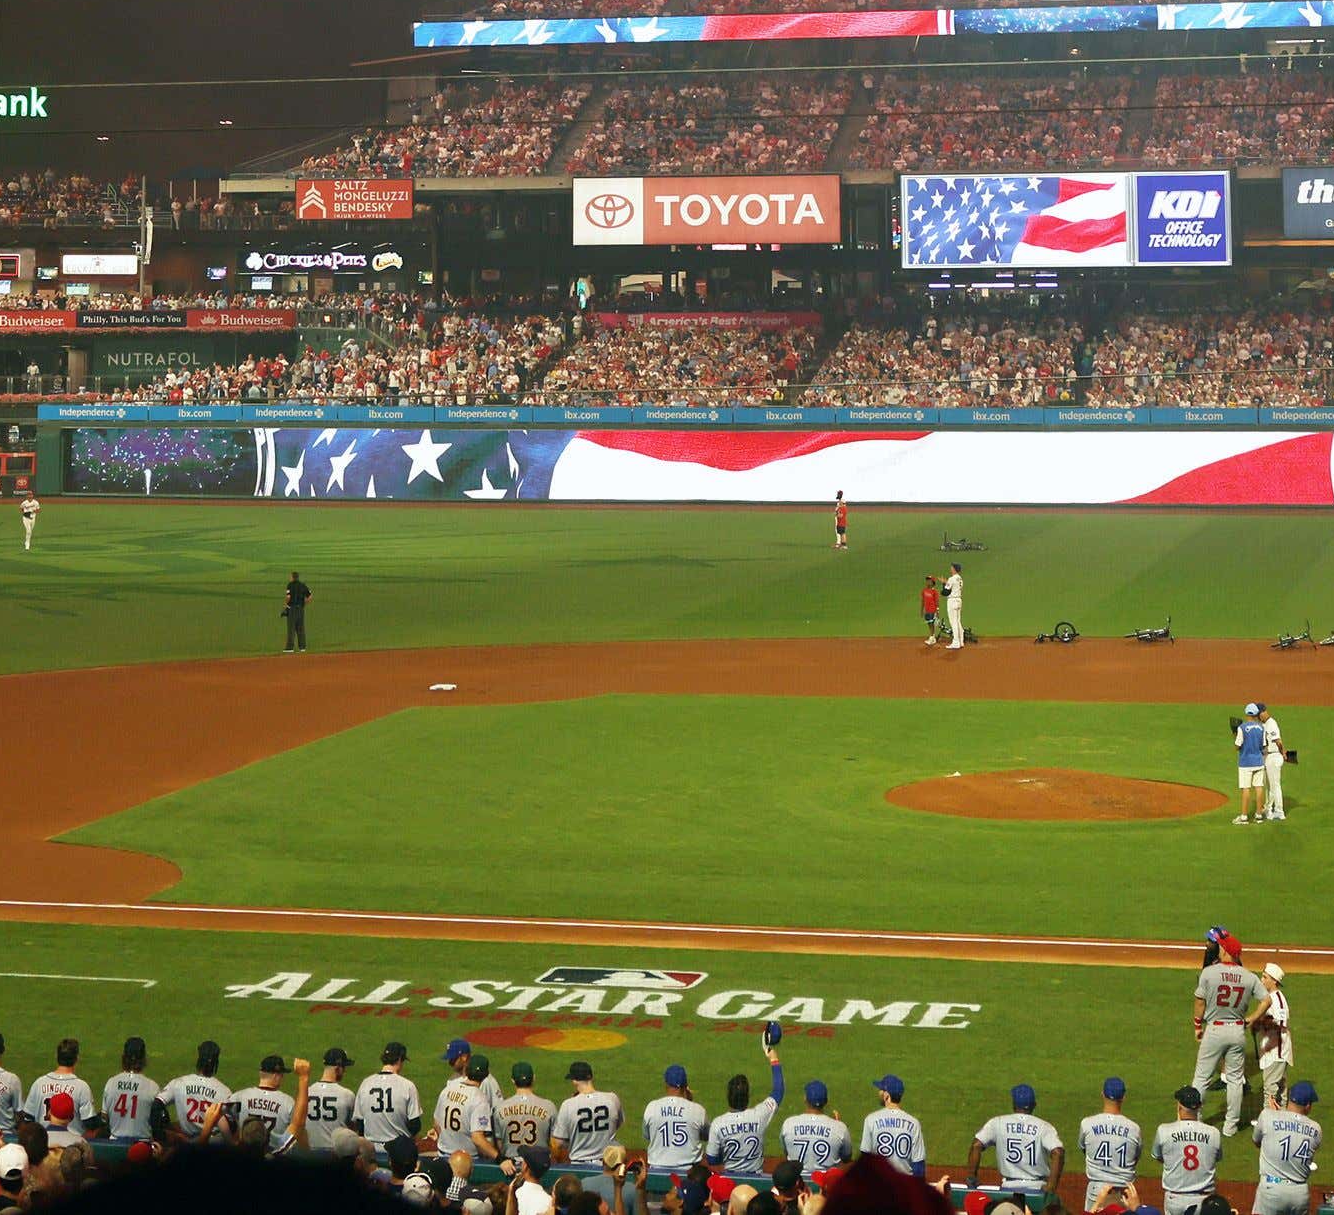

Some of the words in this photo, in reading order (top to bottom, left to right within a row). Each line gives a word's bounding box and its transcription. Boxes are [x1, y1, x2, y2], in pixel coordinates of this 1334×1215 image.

[334, 180, 368, 190] SALTZ
[334, 191, 409, 201] MONGELUZZI
[334, 202, 393, 212] BENDESKY
[654, 192, 824, 227] TOYOTA
[1164, 221, 1202, 234] OFFICE
[1148, 233, 1222, 248] TECHNOLOGY
[83, 315, 108, 324] Philly,
[109, 315, 128, 324] This
[129, 315, 151, 324] Bud's
[152, 315, 166, 324] For
[167, 315, 181, 323] You
[220, 314, 283, 326] Budweiser
[711, 317, 738, 326] Best
[108, 352, 200, 366] NUTRAFOL
[59, 408, 115, 419] Independence
[178, 408, 211, 419] ibx.com
[255, 408, 314, 419] Independence
[369, 410, 403, 420] ibx.com
[448, 410, 508, 421] Independence
[565, 410, 600, 420] ibx.com
[646, 410, 707, 421] Independence
[766, 410, 803, 420] ibx.com
[849, 410, 912, 421] Independence
[973, 410, 1010, 421] ibx.com
[1058, 410, 1123, 421] Independence
[1185, 410, 1224, 421] ibx.com
[1221, 972, 1242, 983] TROUT
[224, 972, 412, 1005] ALL
[427, 980, 683, 1016] STAR
[696, 990, 982, 1029] GAME
[1216, 985, 1245, 1008] 27
[309, 1004, 664, 1029] PHILADELPHIA
[42, 1084, 75, 1095] DINGLER
[117, 1081, 139, 1091] RYAN
[186, 1085, 217, 1098] BUXTON
[114, 1093, 138, 1119] 41
[369, 1087, 395, 1113] 31
[308, 1096, 338, 1121] 35
[661, 1106, 685, 1117] HALE
[444, 1105, 460, 1132] 16
[577, 1106, 609, 1132] 22
[508, 1120, 537, 1145] 23
[658, 1121, 688, 1147] 15
[720, 1122, 759, 1137] CLEMENT
[794, 1125, 831, 1137] POPKINS
[1006, 1122, 1038, 1136] FEBLES
[1092, 1125, 1130, 1138] WALKER
[1273, 1120, 1318, 1138] SCHNEIDER
[1172, 1131, 1211, 1144] SHELTON
[724, 1136, 760, 1162] 22
[793, 1140, 831, 1164] 79
[877, 1133, 912, 1159] 80
[1006, 1138, 1037, 1166] 51
[1279, 1136, 1313, 1164] 14
[1094, 1140, 1127, 1166] 41
[1182, 1144, 1200, 1171] 8
